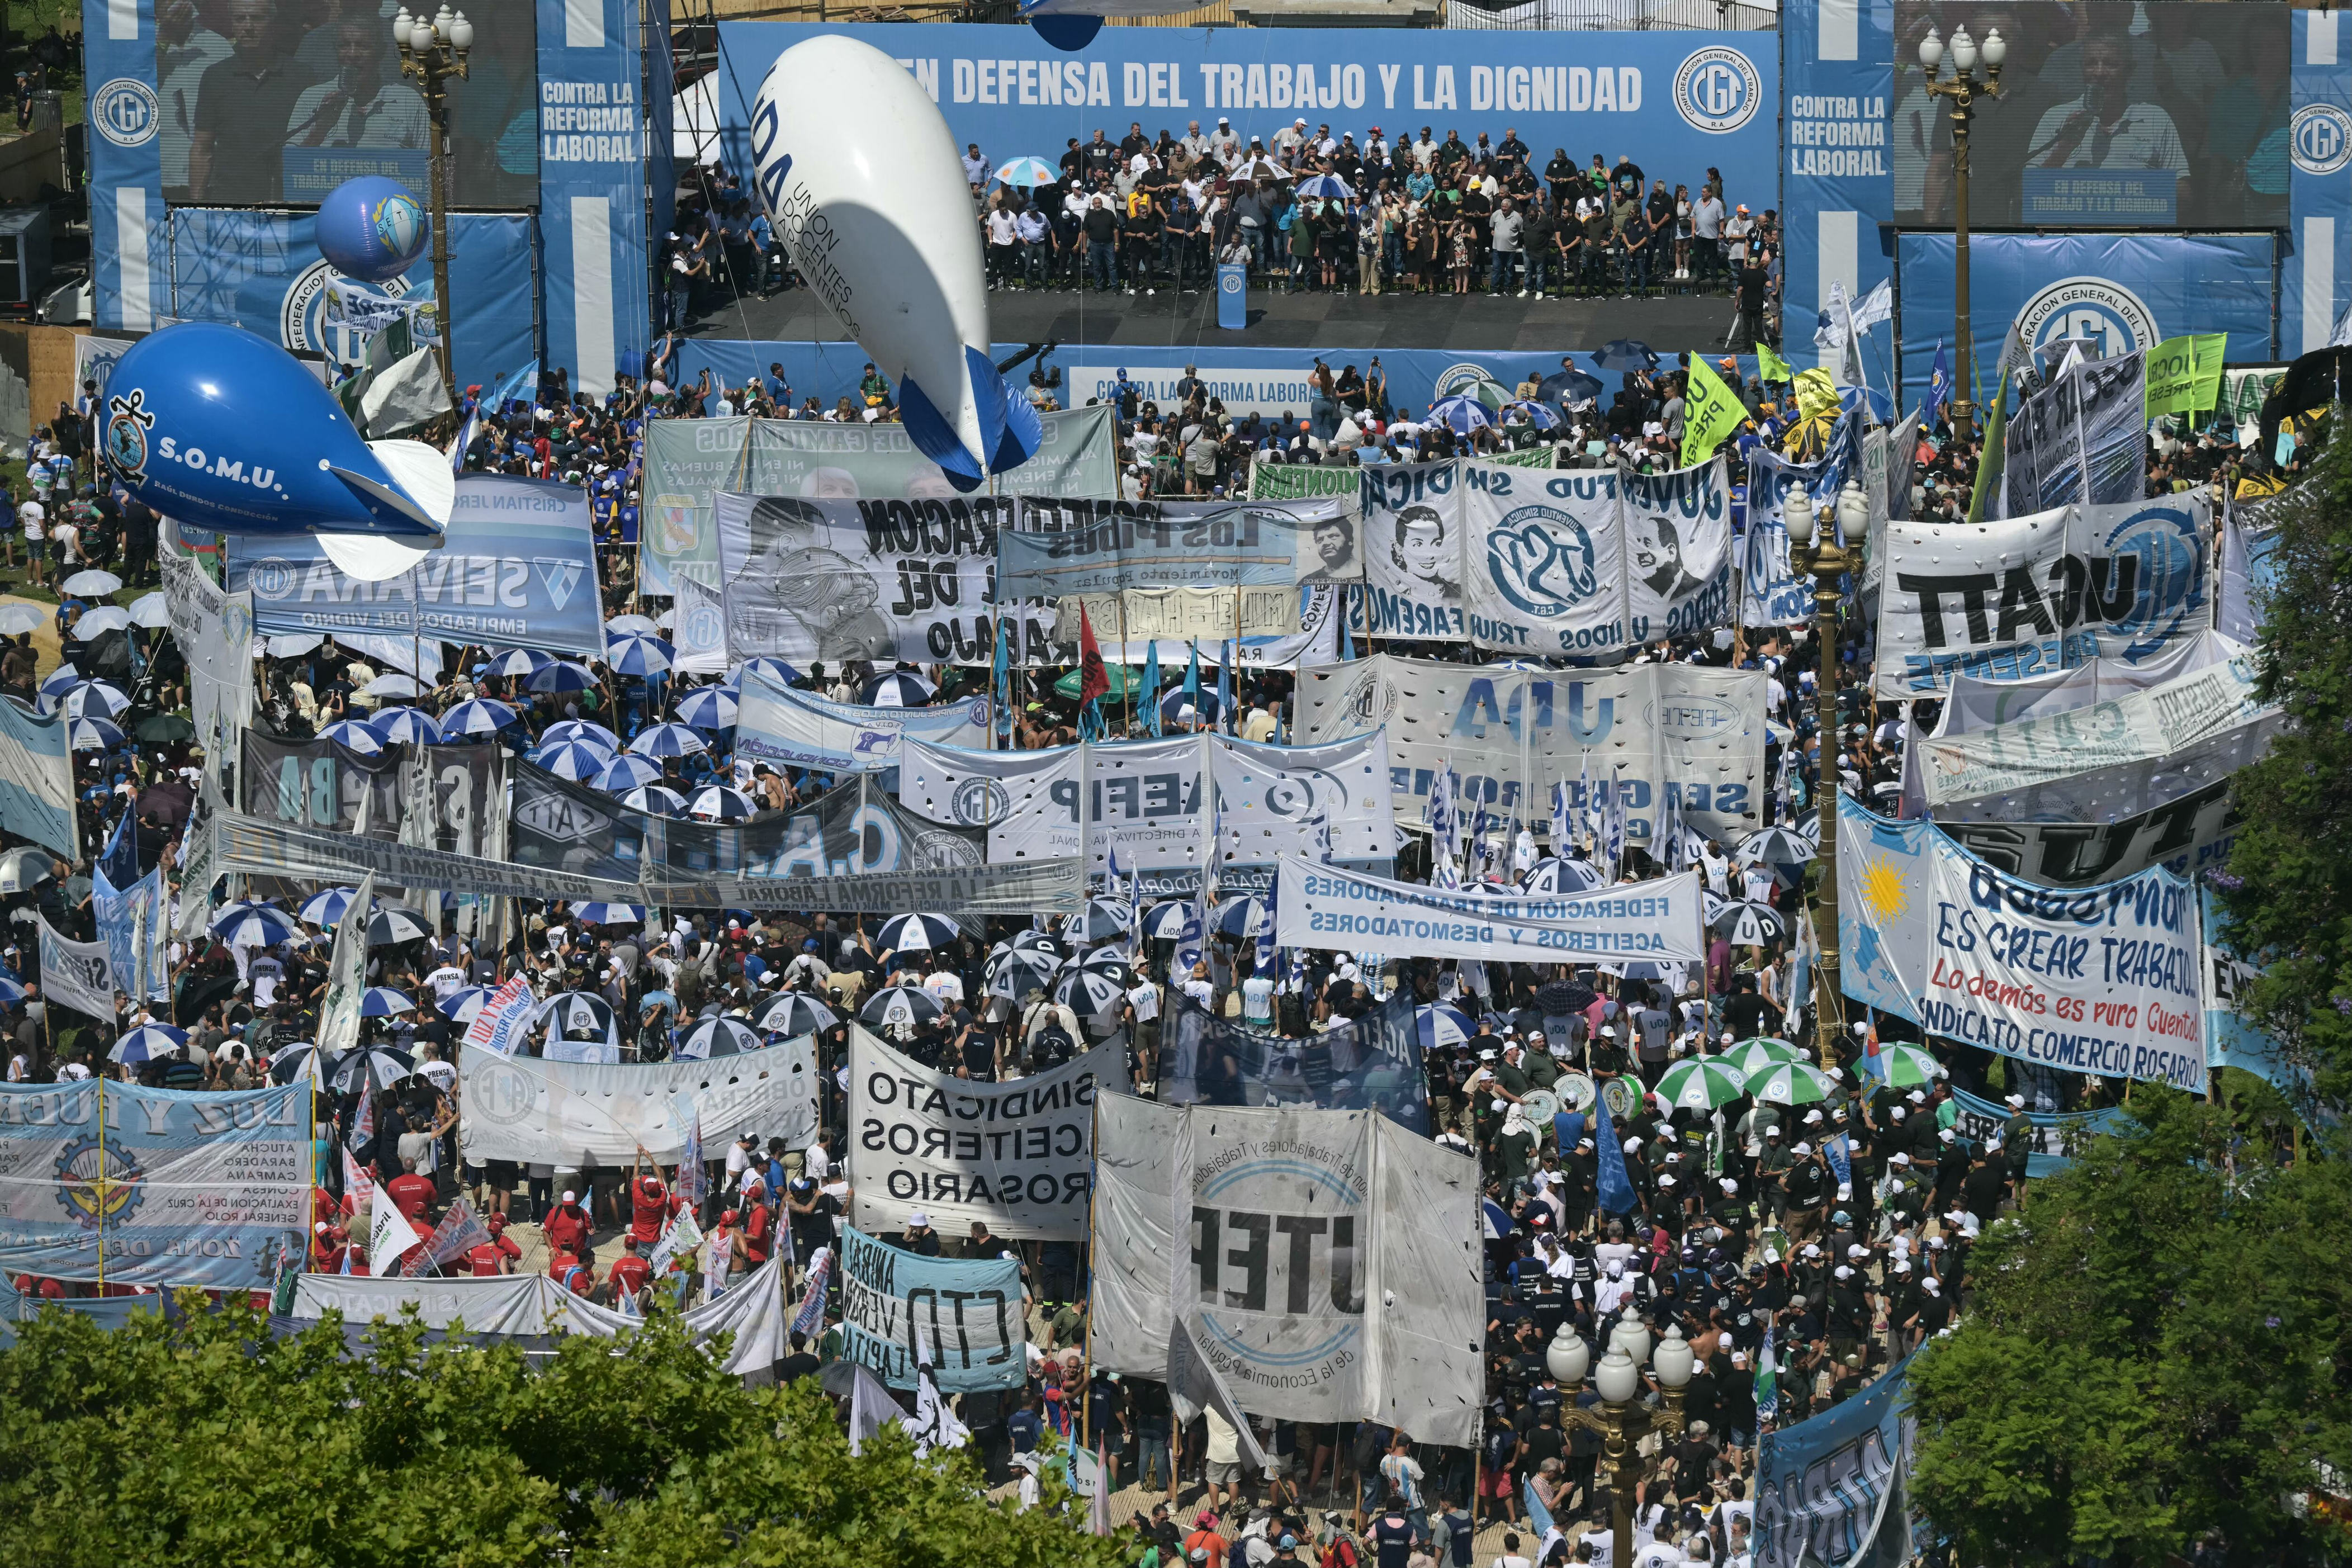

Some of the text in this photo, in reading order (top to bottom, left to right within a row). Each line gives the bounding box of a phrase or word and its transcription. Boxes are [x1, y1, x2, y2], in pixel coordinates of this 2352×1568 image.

[543, 82, 633, 103] CONTRA LA
[953, 59, 1642, 112] DEFENSA DEL TRABAJO Y LA DIGNIDAD
[1680, 53, 1753, 115] CONFEDERACION GENERAL DEL TRABAJO
[98, 87, 113, 131] CONFEDERACION
[115, 84, 140, 92] GENERAL
[141, 91, 152, 102] DEL
[543, 107, 634, 131] REFORMA
[1792, 96, 1885, 119] CONTRA LA
[1792, 121, 1885, 146] REFORMA
[2310, 109, 2350, 157] GENERAL DEL TRABAJO
[545, 134, 637, 162] LABORAL
[313, 159, 401, 175] EN DEFENSA DEL
[1792, 149, 1886, 176] LABORAL
[2055, 180, 2145, 196] EN DEFENSA DEL
[2032, 196, 2168, 212] TRABAJO Y LA DIGNIDAD
[378, 210, 423, 233] SETIA
[794, 181, 840, 252] UNION
[783, 197, 852, 303] DOCENTES
[778, 218, 860, 338] ARGENTINOS
[2061, 290, 2140, 329] GENERAL DEL
[1456, 368, 1481, 378] GENERAL
[1161, 381, 1177, 401] LA
[158, 437, 282, 492] S.O.M.U.
[179, 491, 216, 508] DURDOS
[217, 504, 279, 522] CONDUCCIÓN
[1748, 875, 1766, 884] UDA
[1163, 927, 1181, 936] UDA
[1937, 901, 1977, 952] ES
[1987, 922, 2089, 979] CREAR
[2100, 937, 2196, 999] TRABAJO...
[254, 964, 277, 973] PRENSA
[436, 973, 460, 982] PRENSA
[487, 977, 526, 1010] FUERZA
[1138, 991, 1154, 1005] UDA
[1247, 993, 1266, 1003] UDA
[1932, 958, 2198, 1042] Lo demás es Cuento!
[479, 1008, 498, 1019] Y
[470, 1018, 495, 1044] LUZ
[490, 1019, 511, 1051] MOSER
[427, 1069, 451, 1079] PRENSA
[1772, 1084, 1784, 1096] 62
